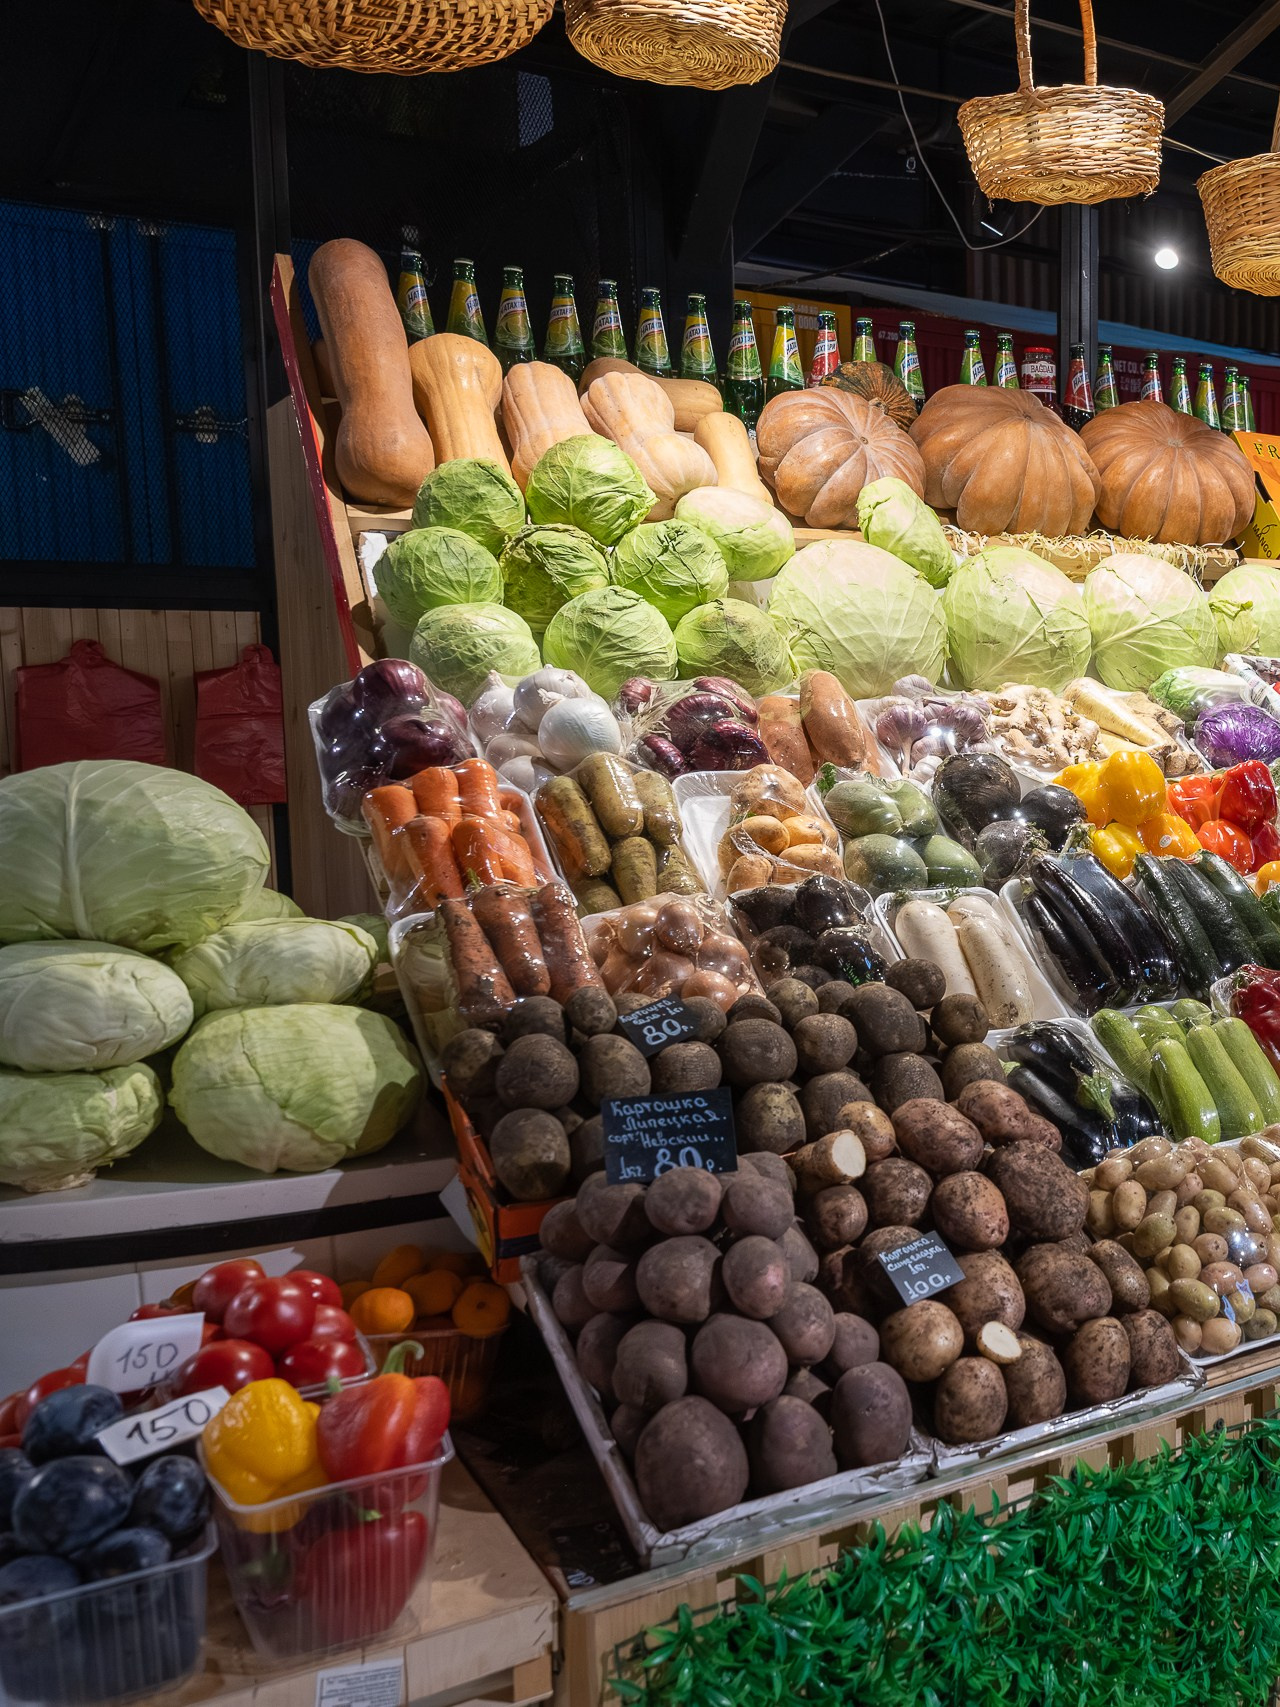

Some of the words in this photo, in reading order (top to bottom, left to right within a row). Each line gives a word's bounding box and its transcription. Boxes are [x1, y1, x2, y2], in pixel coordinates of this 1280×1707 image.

[1252, 523, 1273, 559] MANGO
[610, 1097, 708, 1118] Картошка
[115, 1342, 178, 1374] 150
[126, 1398, 211, 1445] 150
